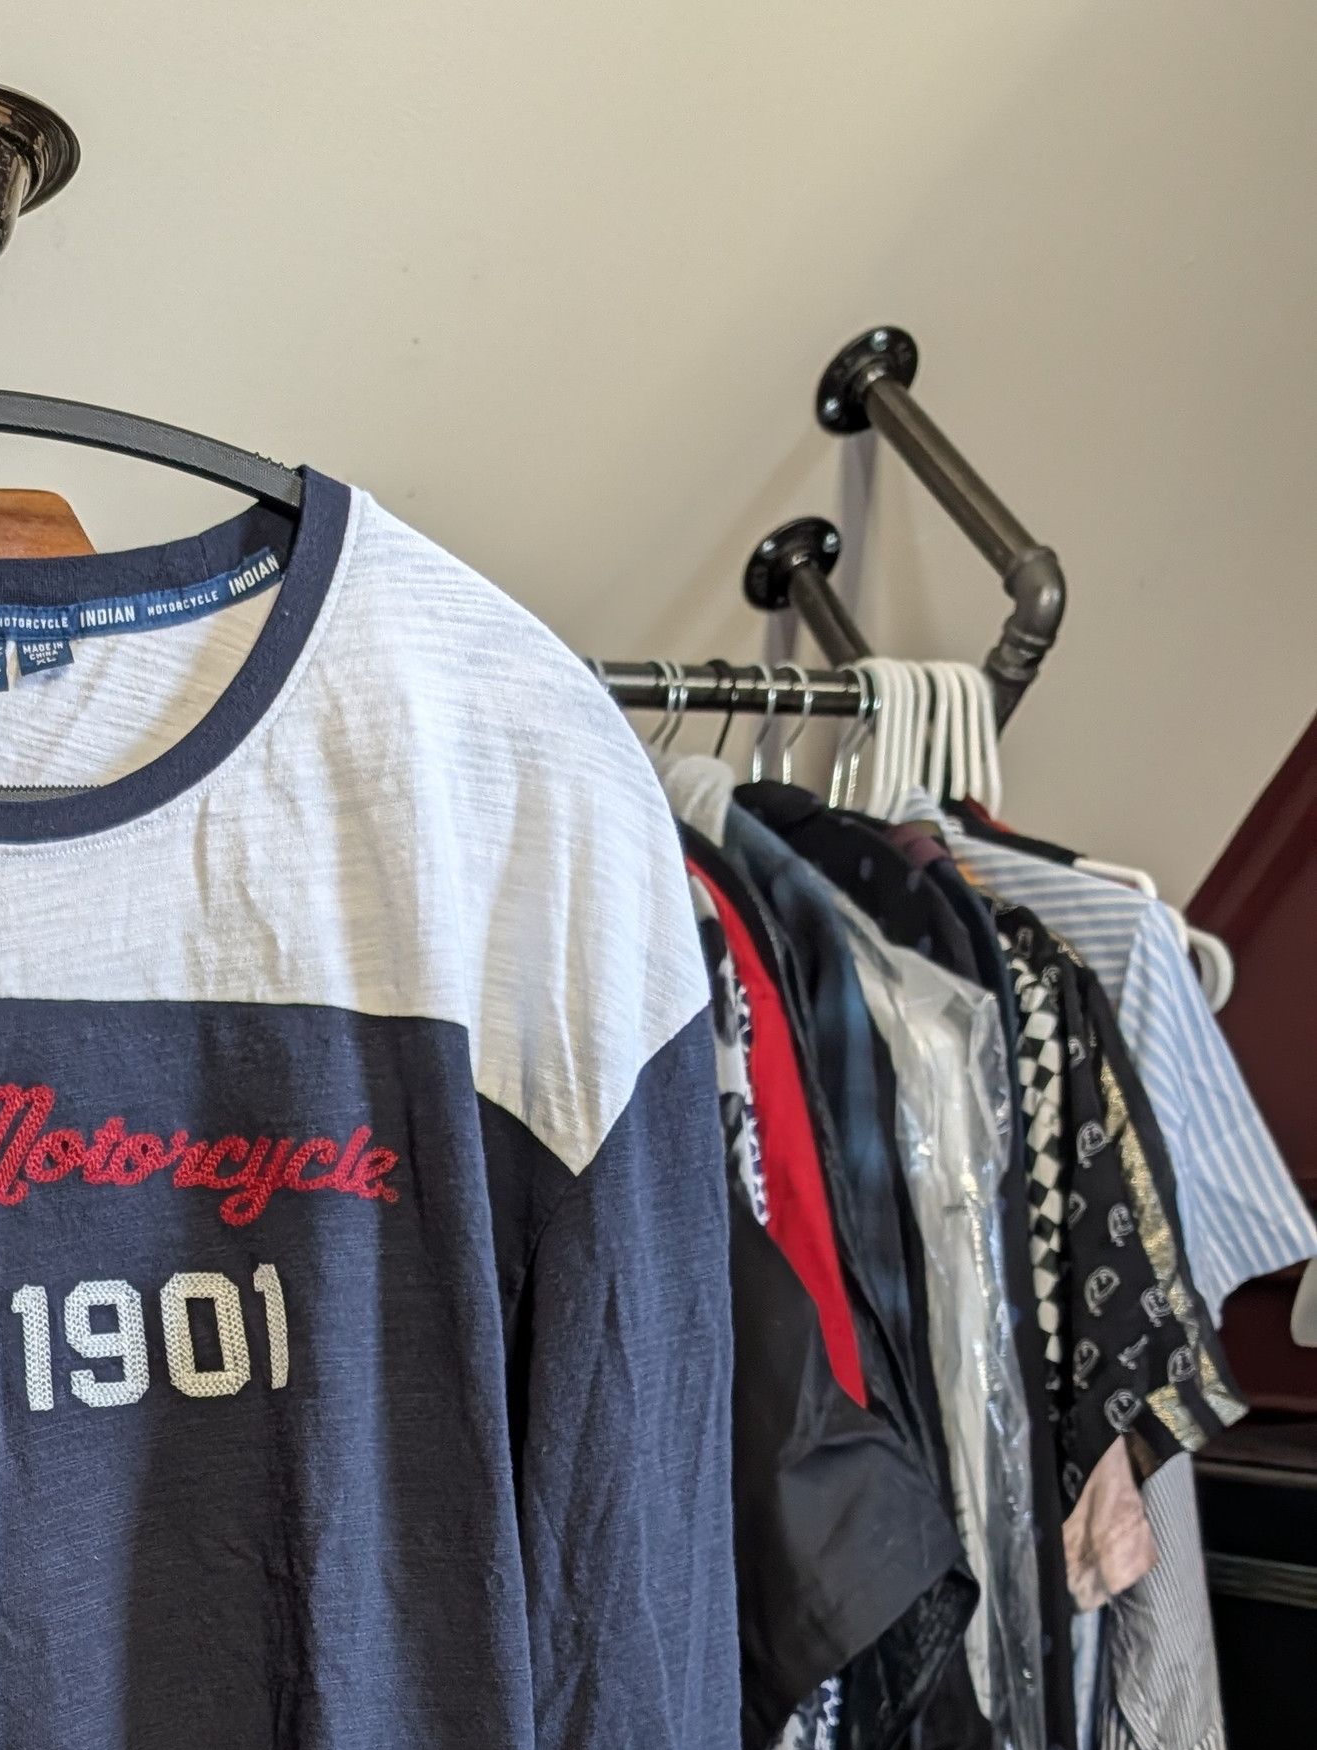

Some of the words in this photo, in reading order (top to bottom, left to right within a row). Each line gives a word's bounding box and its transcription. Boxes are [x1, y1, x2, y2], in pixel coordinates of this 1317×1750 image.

[80, 606, 135, 628] INDIAN
[147, 590, 219, 617] MOTORCYCLE
[228, 554, 280, 596] INDIAN
[22, 643, 51, 655] MADE
[52, 641, 63, 650] IN
[29, 650, 58, 661] CHINA
[36, 657, 57, 666] XL
[11, 1263, 289, 1413] 1901
